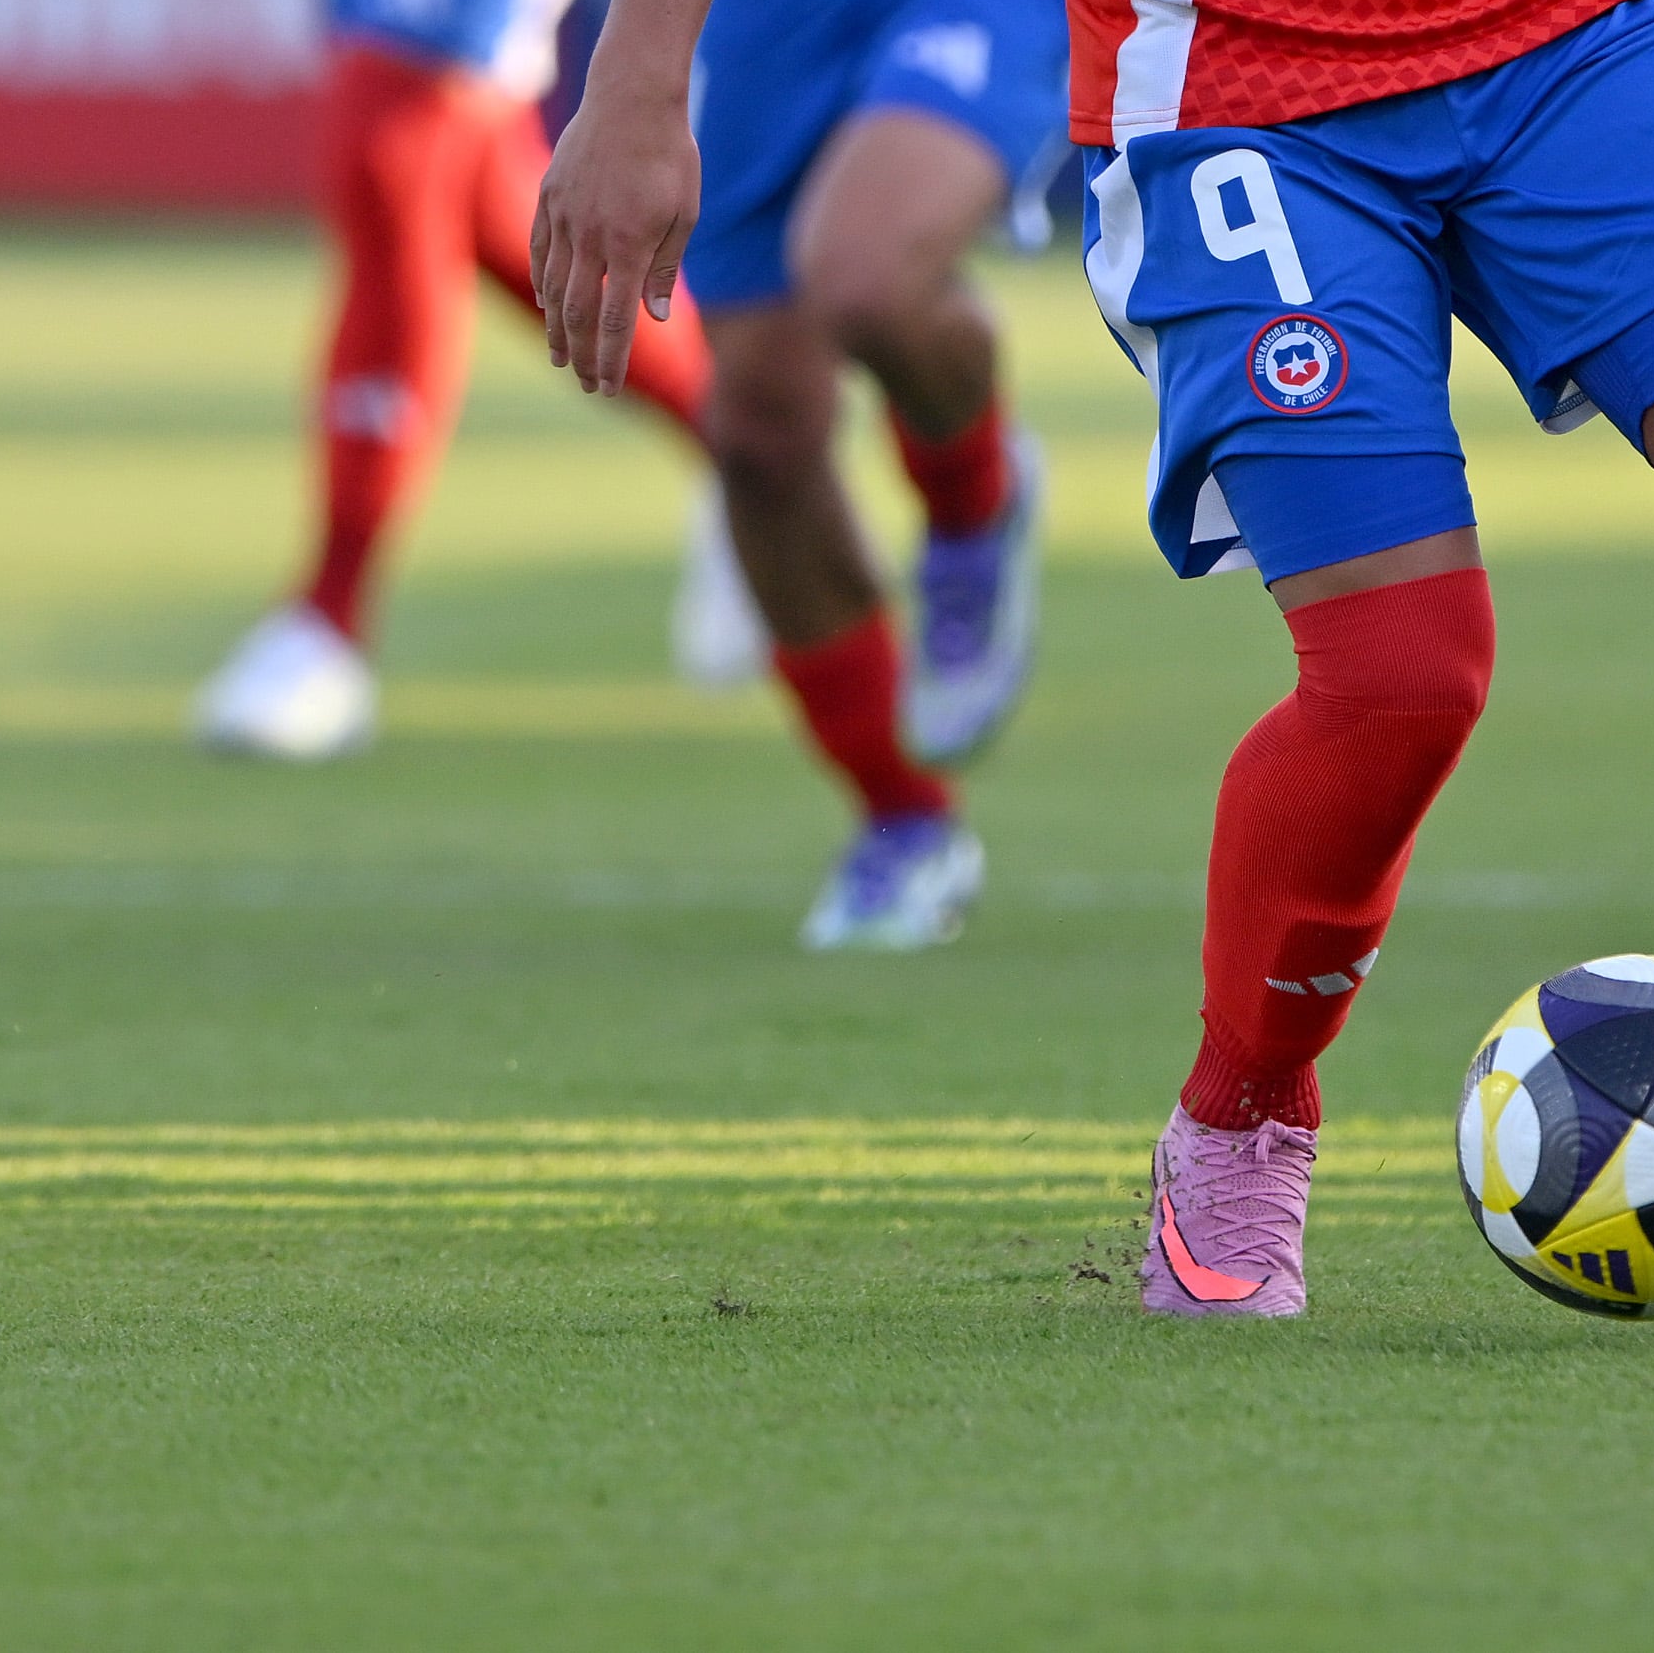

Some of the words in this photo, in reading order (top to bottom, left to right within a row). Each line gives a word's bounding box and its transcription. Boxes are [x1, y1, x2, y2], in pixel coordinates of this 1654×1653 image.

[1189, 147, 1314, 306] 9
[1255, 322, 1289, 375] FEDERACION
[1295, 321, 1307, 333] DE
[1310, 326, 1338, 358] FUTBOL
[1283, 395, 1297, 406] DE
[1302, 385, 1329, 405] CHILE
